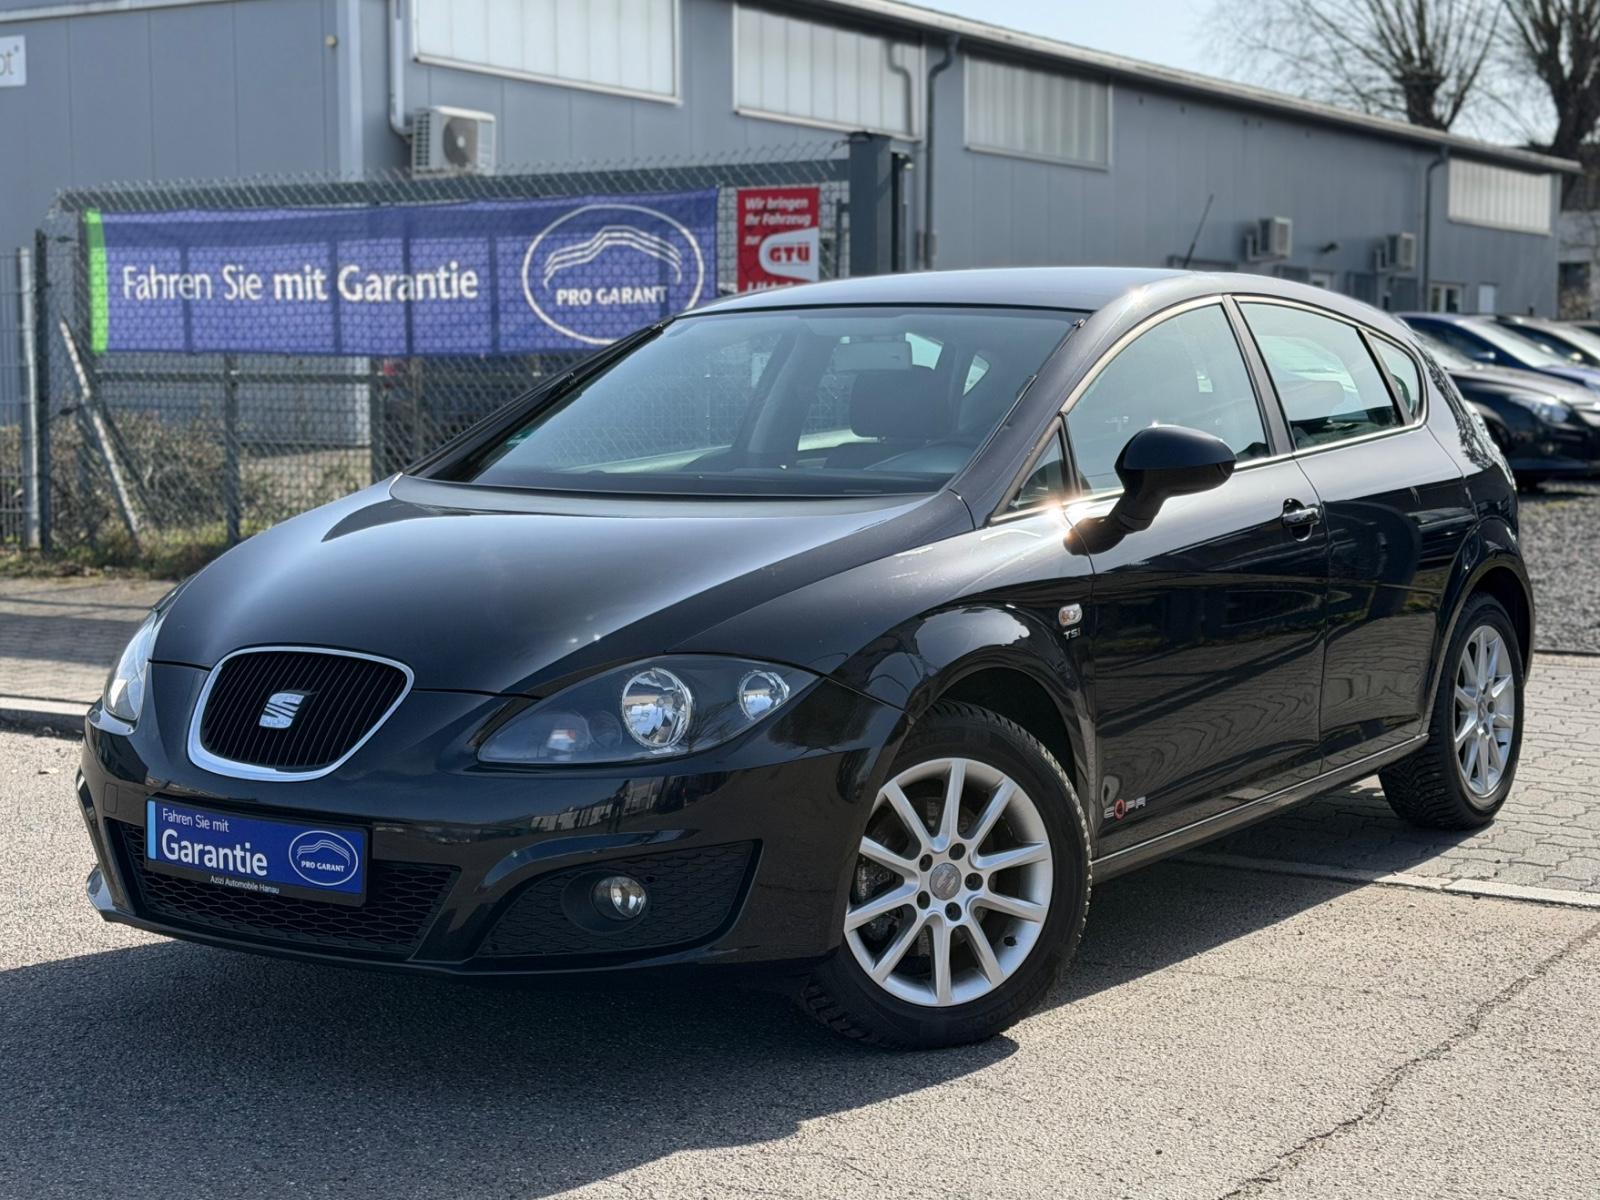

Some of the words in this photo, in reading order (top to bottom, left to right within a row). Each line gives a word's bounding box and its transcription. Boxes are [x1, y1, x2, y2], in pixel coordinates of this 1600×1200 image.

[745, 197, 765, 210] Wir
[767, 196, 809, 211] bringen
[745, 213, 761, 226] Ihr
[762, 212, 811, 226] Fahrzeug
[769, 243, 810, 263] GTÜ
[123, 264, 212, 300] Fahren
[222, 264, 263, 300] Sie
[274, 264, 328, 301] mit
[337, 260, 479, 301] Garantie
[556, 288, 592, 306] PRO
[595, 285, 667, 305] GARANT
[162, 808, 193, 827] Fahren
[195, 814, 211, 831] Sie
[212, 818, 230, 833] mit
[161, 828, 268, 876] Garantie
[301, 860, 316, 871] PRO
[316, 862, 345, 873] GARANT
[210, 875, 225, 886] Azizi
[225, 877, 258, 891] Automobile
[259, 883, 280, 895] Hanau
